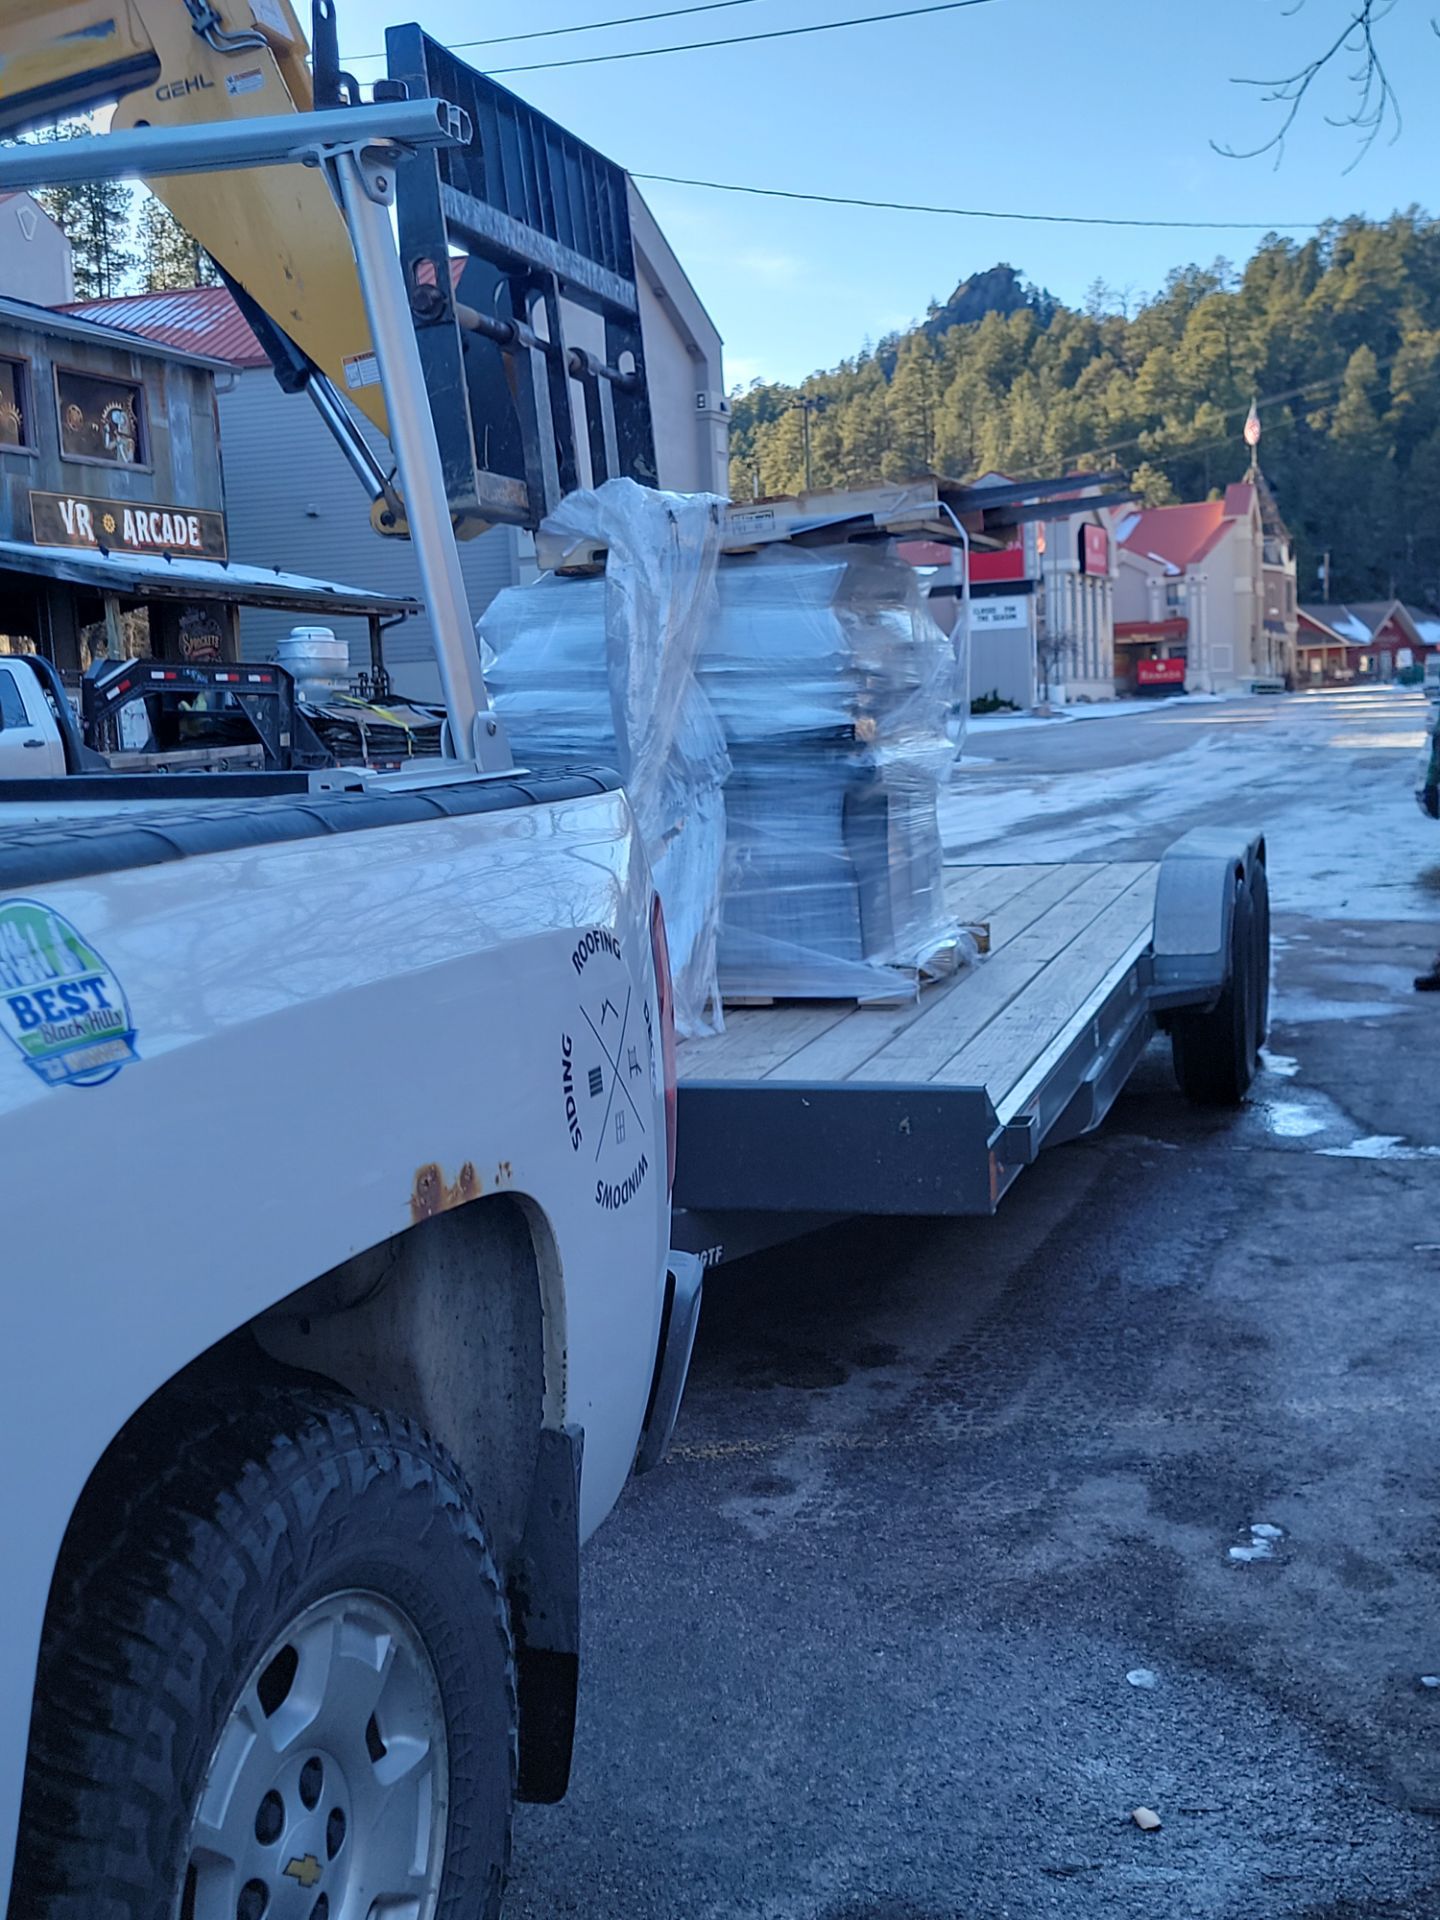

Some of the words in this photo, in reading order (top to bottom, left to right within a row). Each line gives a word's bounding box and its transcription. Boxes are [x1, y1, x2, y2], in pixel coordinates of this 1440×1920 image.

[155, 75, 214, 102] GEHL
[58, 498, 96, 542] VR
[123, 508, 202, 547] ARCADE
[572, 929, 623, 976] ROOFING
[7, 977, 112, 1030] BEST
[40, 1019, 86, 1044] Black
[87, 1009, 122, 1032] Hills
[561, 1033, 583, 1152] SIDING
[595, 1153, 648, 1211] WINDOWS
